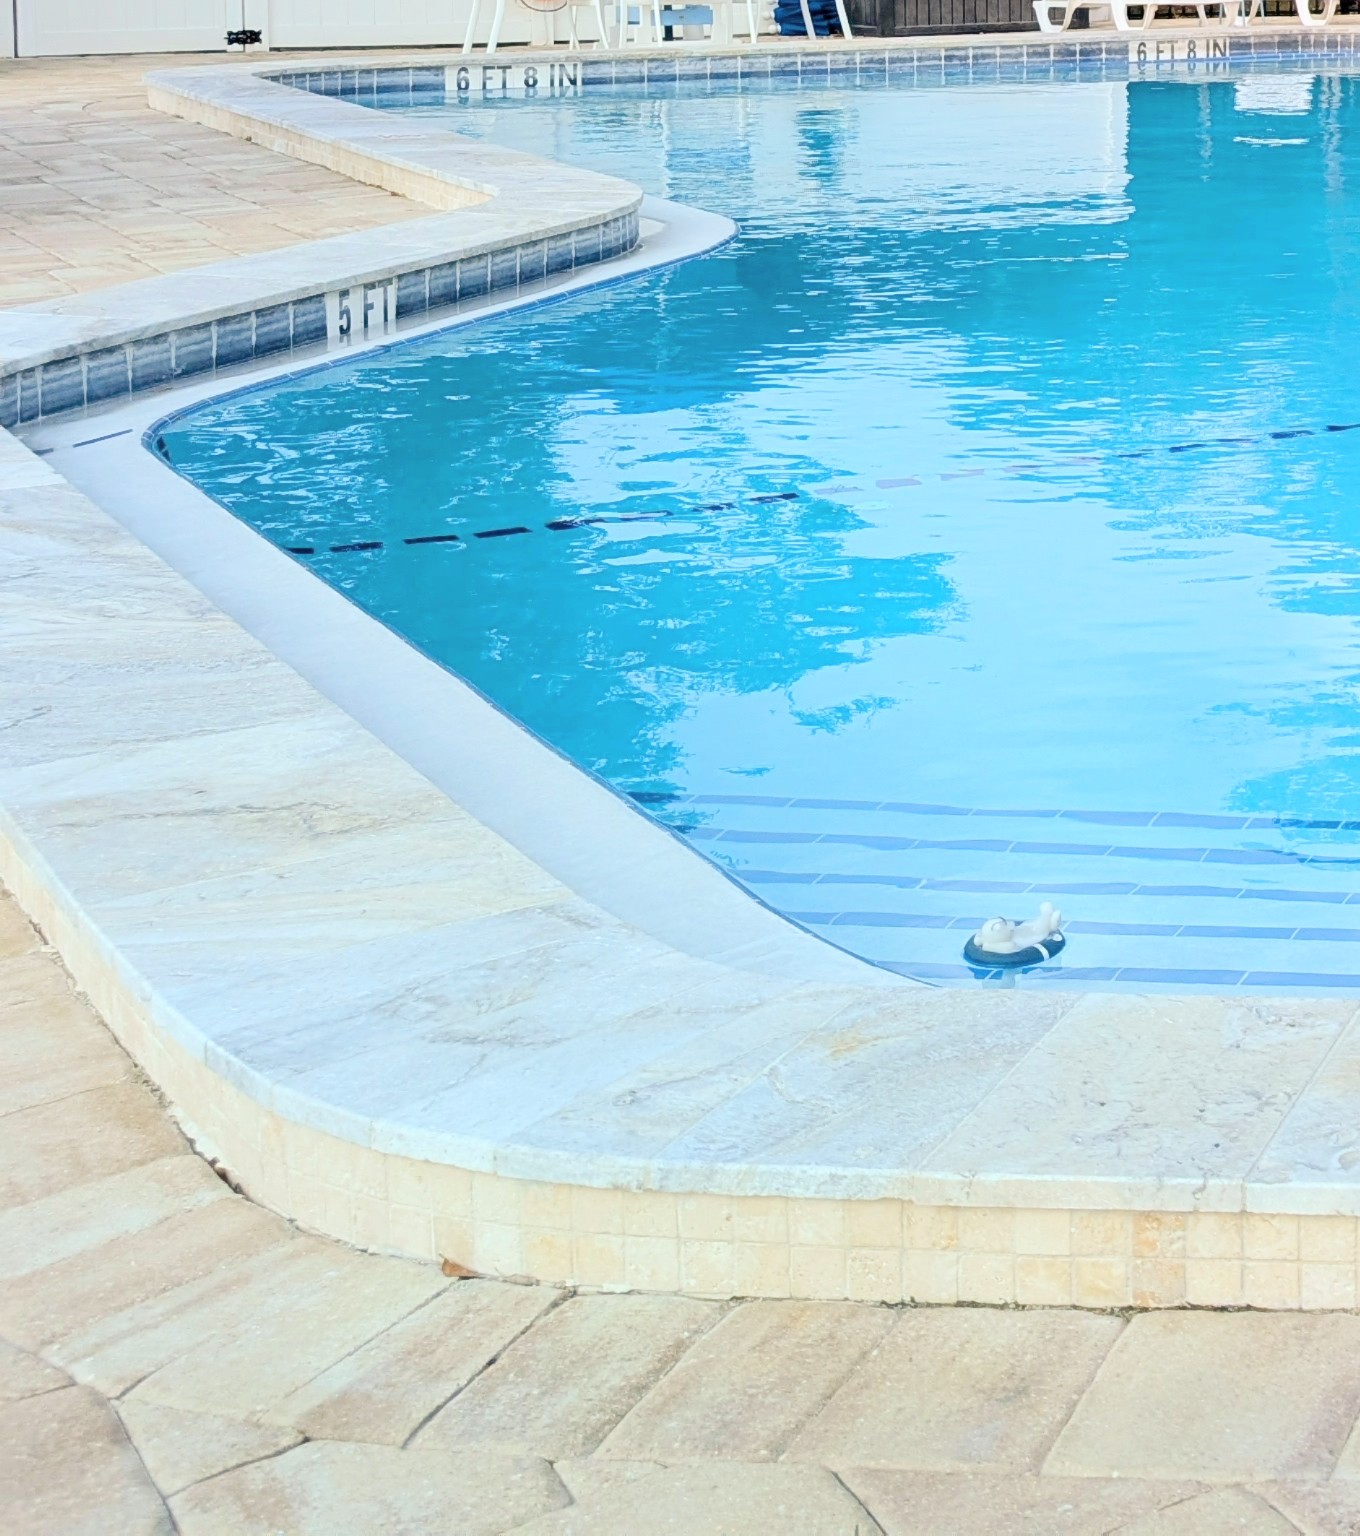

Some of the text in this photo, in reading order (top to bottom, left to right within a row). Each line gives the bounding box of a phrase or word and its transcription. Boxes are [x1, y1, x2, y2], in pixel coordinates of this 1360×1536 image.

[1137, 38, 1227, 62] 6 FT 8 IN
[456, 63, 578, 91] 6 FT 8 IN
[338, 278, 394, 336] 5 FT
